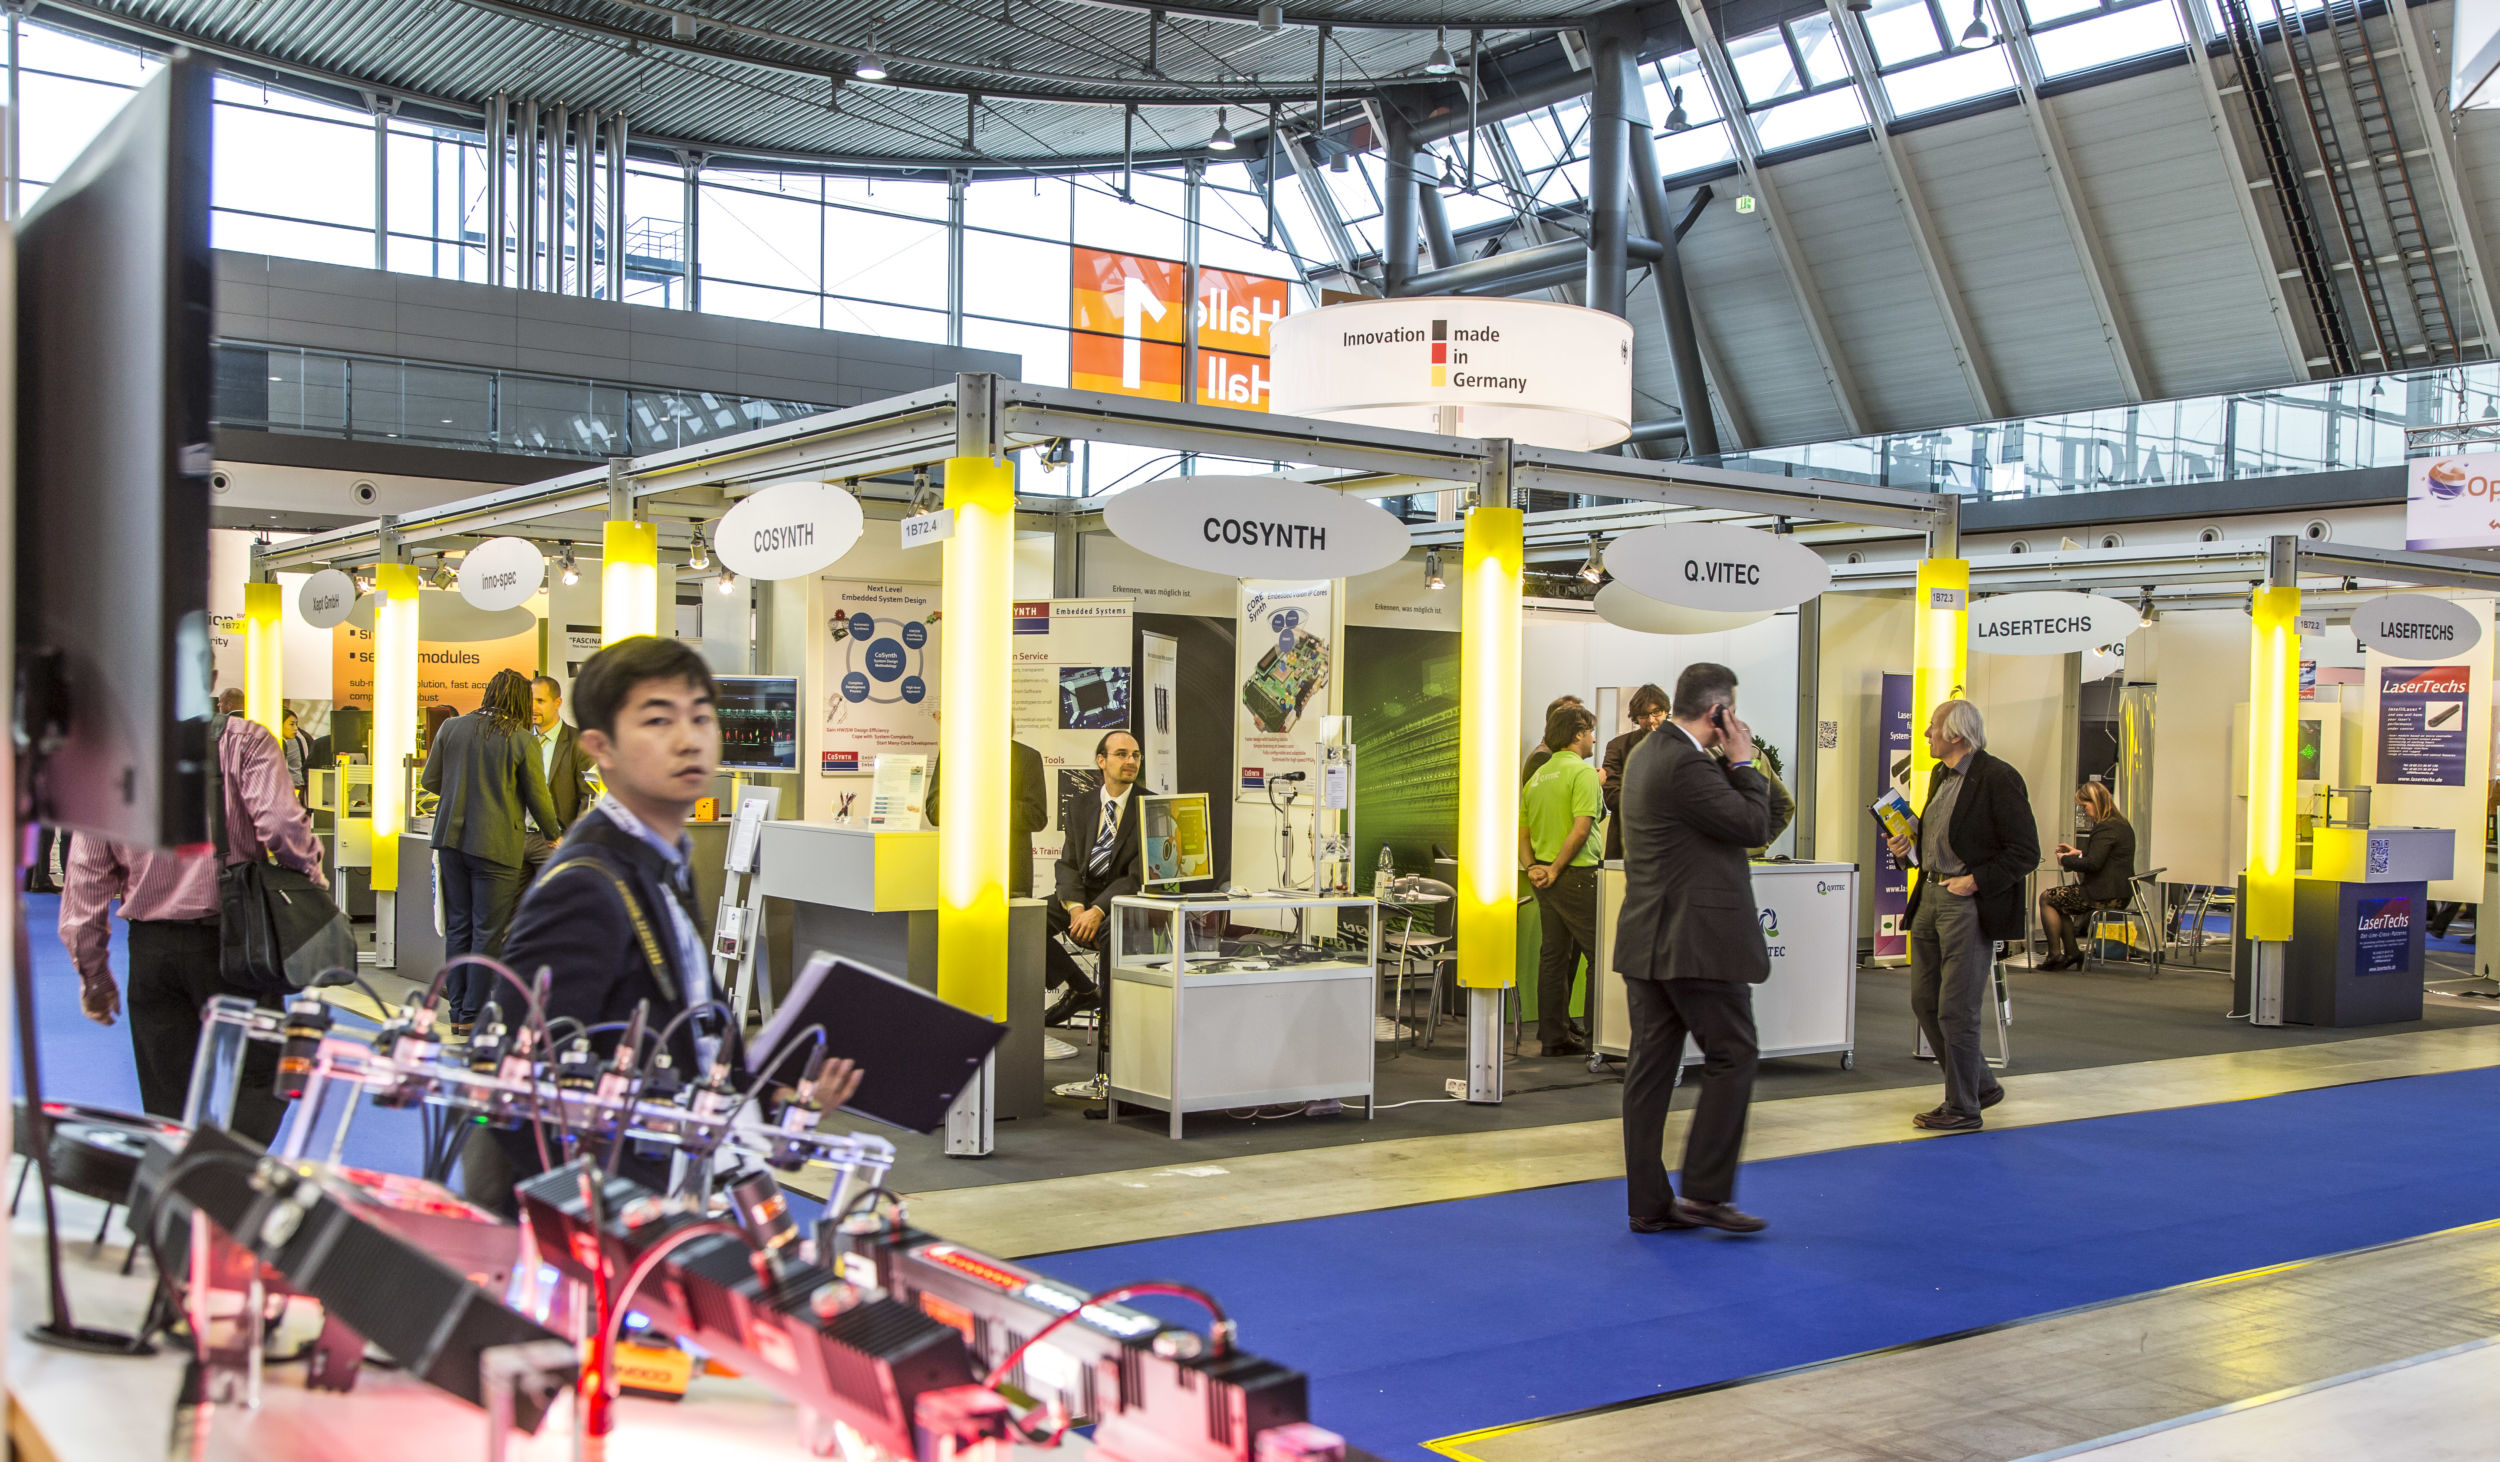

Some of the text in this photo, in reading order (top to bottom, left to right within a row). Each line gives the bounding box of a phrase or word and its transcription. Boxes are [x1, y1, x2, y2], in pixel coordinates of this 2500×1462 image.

[1343, 326, 1500, 347] Innovation made
[1453, 349, 1468, 364] in
[1453, 372, 1527, 393] Germany
[2467, 475, 2500, 502] Op
[905, 519, 937, 537] 1B72.4
[1203, 517, 1326, 550] COSYNTH
[754, 522, 814, 553] COSYNTH
[1684, 559, 1760, 585] Q.VITEC
[482, 571, 517, 591] inno-spec
[884, 585, 903, 593] Level
[325, 594, 340, 609] GmbH
[841, 594, 927, 606] Embedded System Design
[1013, 607, 1037, 616] YNTH
[1056, 607, 1126, 616] Embedded Systems
[1978, 616, 2092, 638] LASERTECHS
[2380, 621, 2454, 641] LASERTECHS
[418, 650, 480, 664] modules
[1019, 652, 1049, 660] Service
[450, 680, 469, 689] fast
[2381, 679, 2468, 694] LaserTechs
[350, 692, 439, 703] comp bust
[1890, 731, 1912, 741] System-
[1043, 756, 1065, 765] Tools
[1039, 846, 1062, 855] Traini
[2358, 913, 2409, 931] LaserTechs
[1767, 946, 1786, 957] TEC
